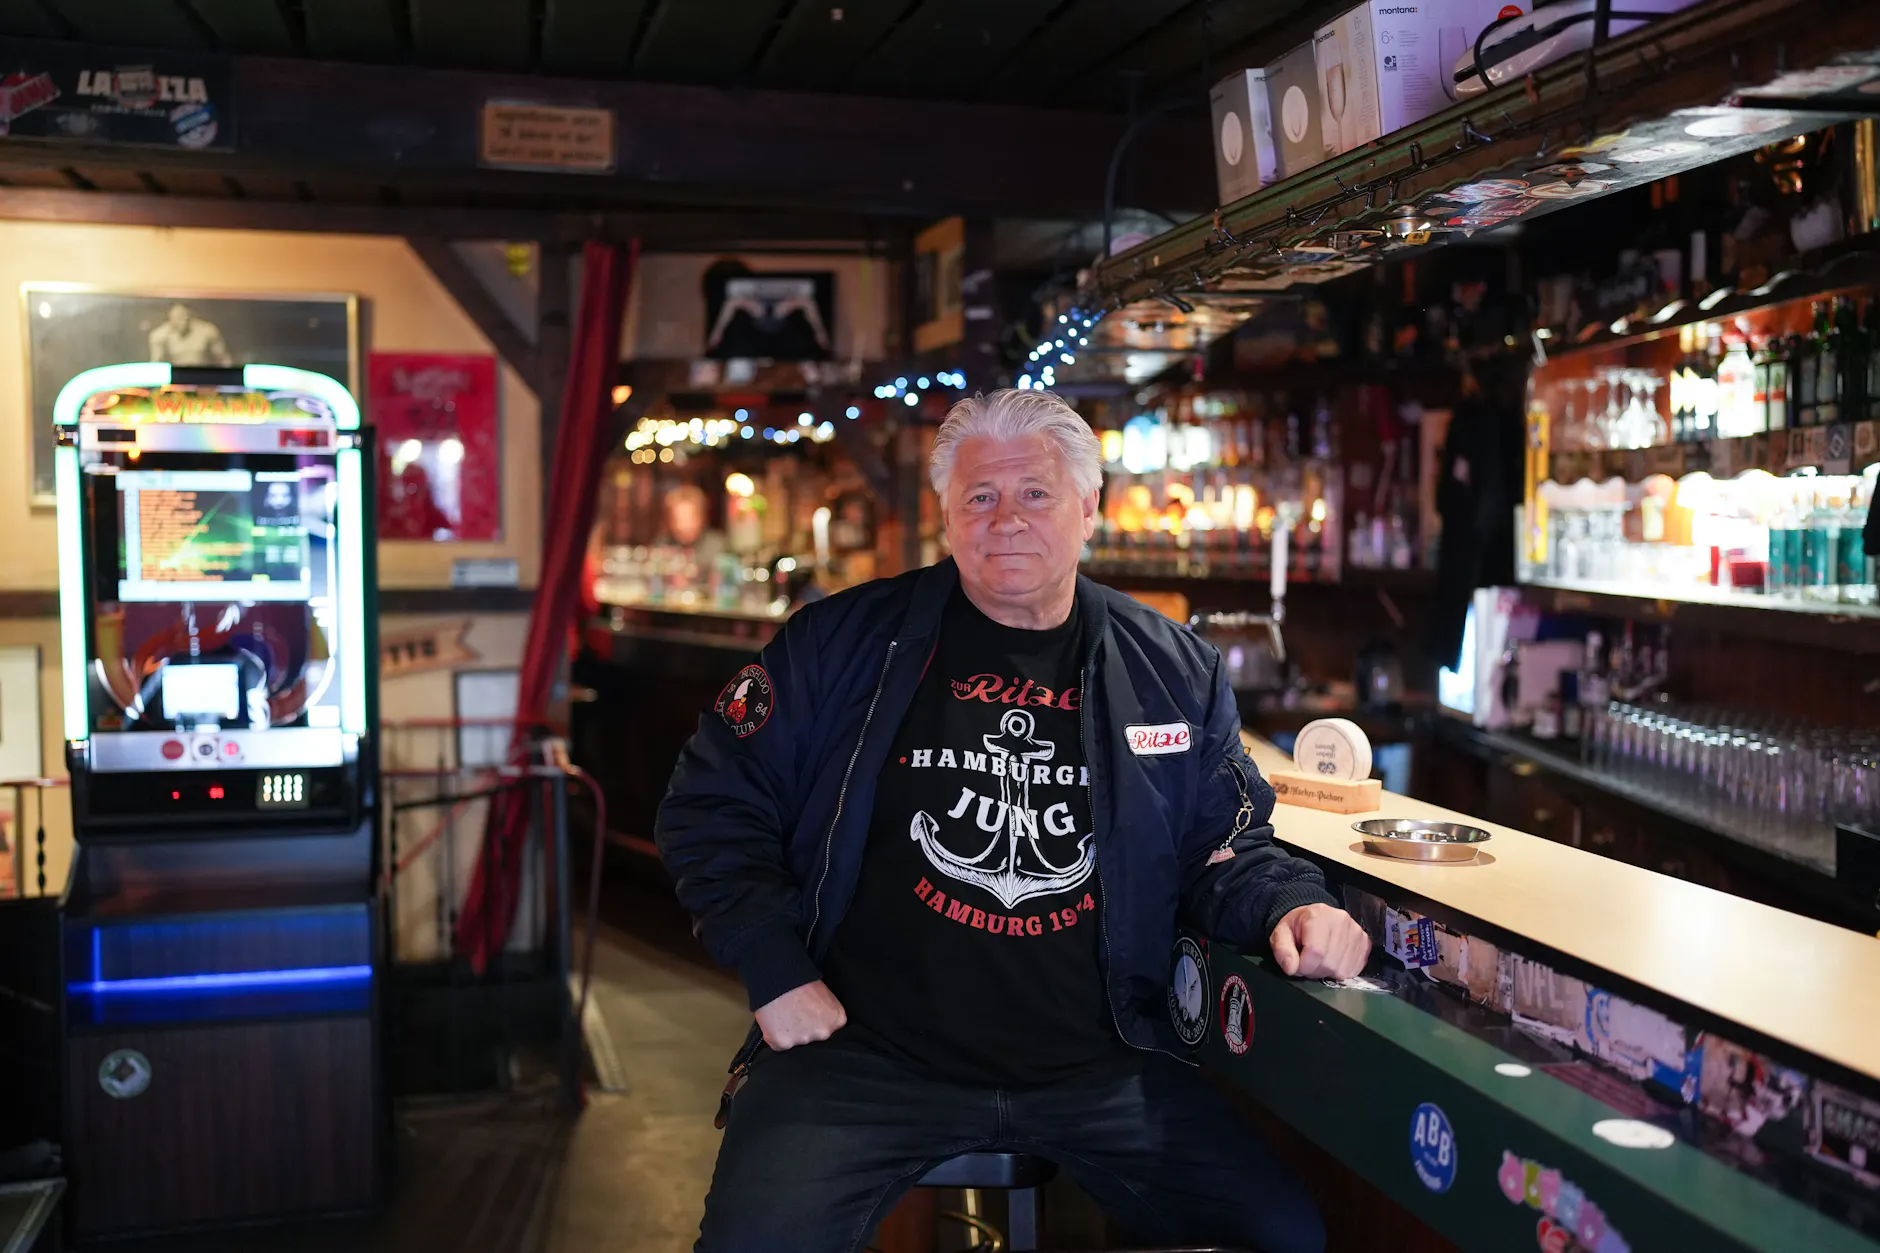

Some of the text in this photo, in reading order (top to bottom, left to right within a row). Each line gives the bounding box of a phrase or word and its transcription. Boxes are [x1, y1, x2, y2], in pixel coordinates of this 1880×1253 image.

[154, 395, 269, 423] WIZARD
[740, 667, 770, 695] BUSHIDO
[950, 679, 971, 692] ZUR
[755, 702, 768, 717] 84
[1132, 731, 1190, 750] Ritze
[947, 786, 1077, 840] JUNG
[913, 876, 1043, 937] HAMBURG
[1182, 942, 1203, 969] KURTO
[1415, 1112, 1450, 1166] ABB
